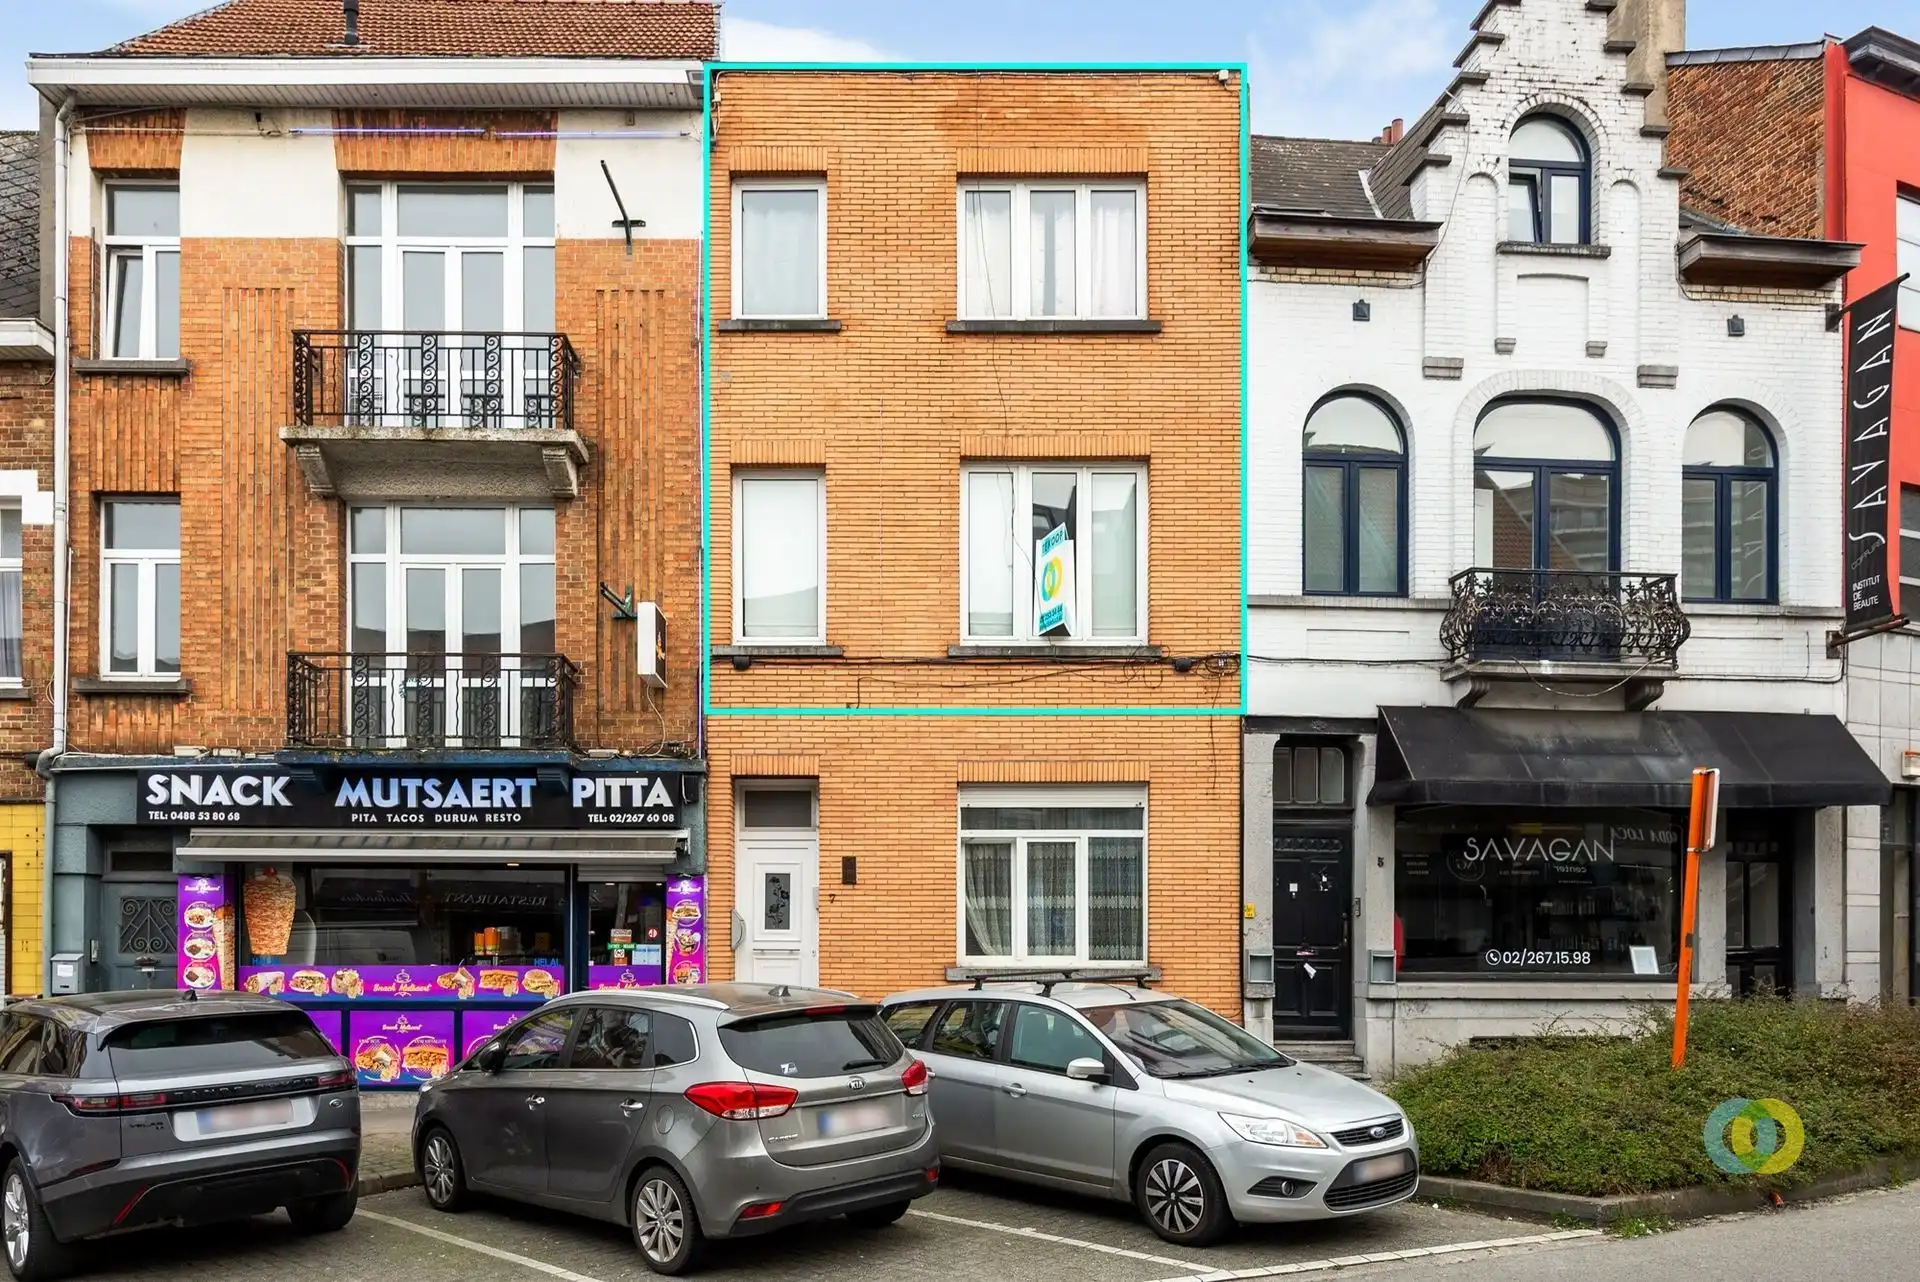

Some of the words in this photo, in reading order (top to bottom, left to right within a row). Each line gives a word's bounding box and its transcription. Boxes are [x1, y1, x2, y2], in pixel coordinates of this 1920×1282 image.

[1849, 308, 1893, 544] SAVAGAN
[1852, 575, 1881, 592] INSTITUT
[1852, 590, 1862, 602] DE
[1853, 595, 1879, 611] BEAUTE
[146, 774, 293, 807] SNACK
[334, 777, 537, 808] MUTSAERT
[572, 777, 675, 808] PITTA
[148, 811, 169, 821] TEL:
[170, 811, 196, 821] 0488
[197, 811, 211, 821] 53
[212, 811, 226, 821] 80
[227, 811, 240, 821] 68
[351, 813, 377, 823] PITA
[386, 813, 425, 823] TACOS
[434, 813, 478, 823] DURUM
[485, 813, 522, 823] RESTO
[588, 813, 608, 823] TEL:
[609, 813, 645, 824] 02/267
[646, 813, 661, 823] 60
[661, 813, 675, 823] 08
[1463, 837, 1615, 862] SAVAGAN
[1377, 857, 1385, 867] 5
[829, 894, 836, 903] 7
[1502, 948, 1591, 967] 02/267.15.98
